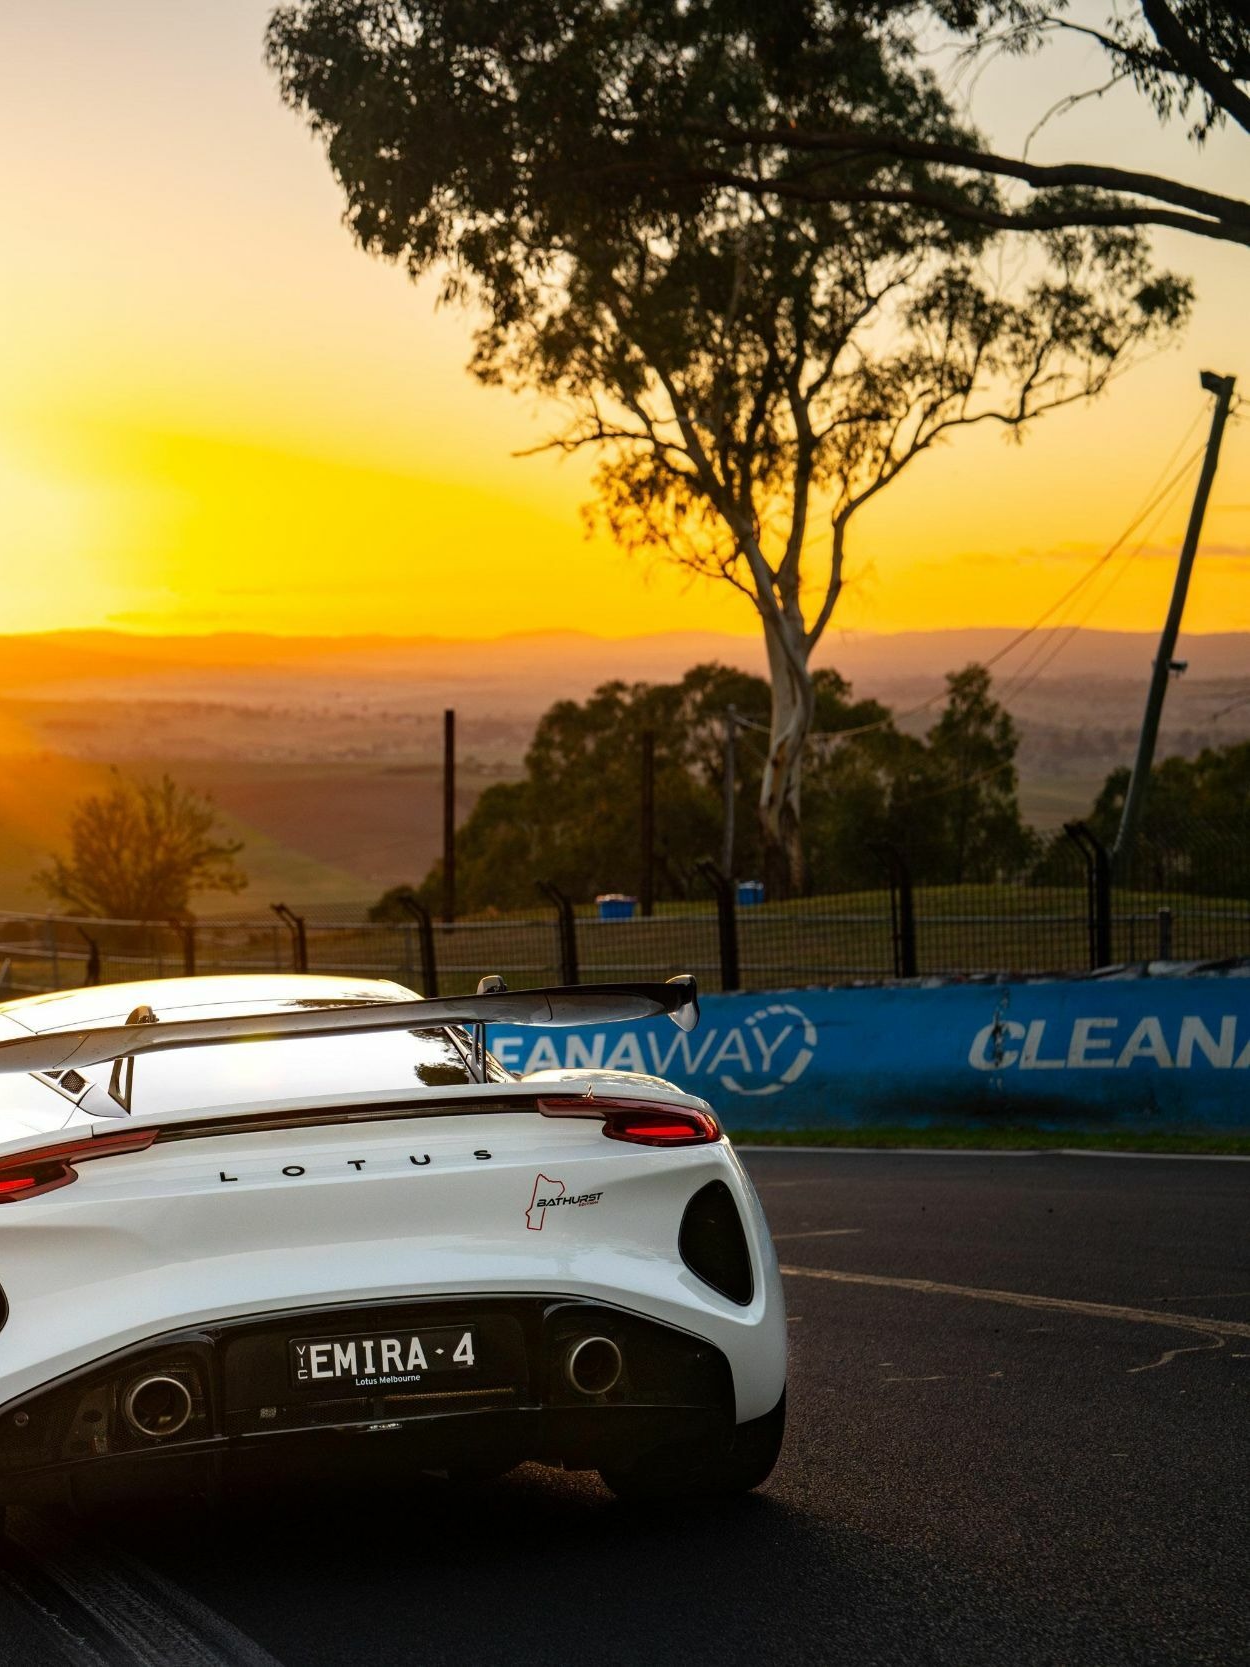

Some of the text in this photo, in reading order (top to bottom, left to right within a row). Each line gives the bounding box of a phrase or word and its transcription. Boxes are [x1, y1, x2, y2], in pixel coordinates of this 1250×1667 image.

[492, 1025, 794, 1076] EANAWAY
[968, 1016, 1250, 1071] CLEAN
[219, 1149, 492, 1183] LOTUS
[537, 1192, 604, 1207] BATHURST
[355, 1374, 421, 1386] Lotus Melbourne
